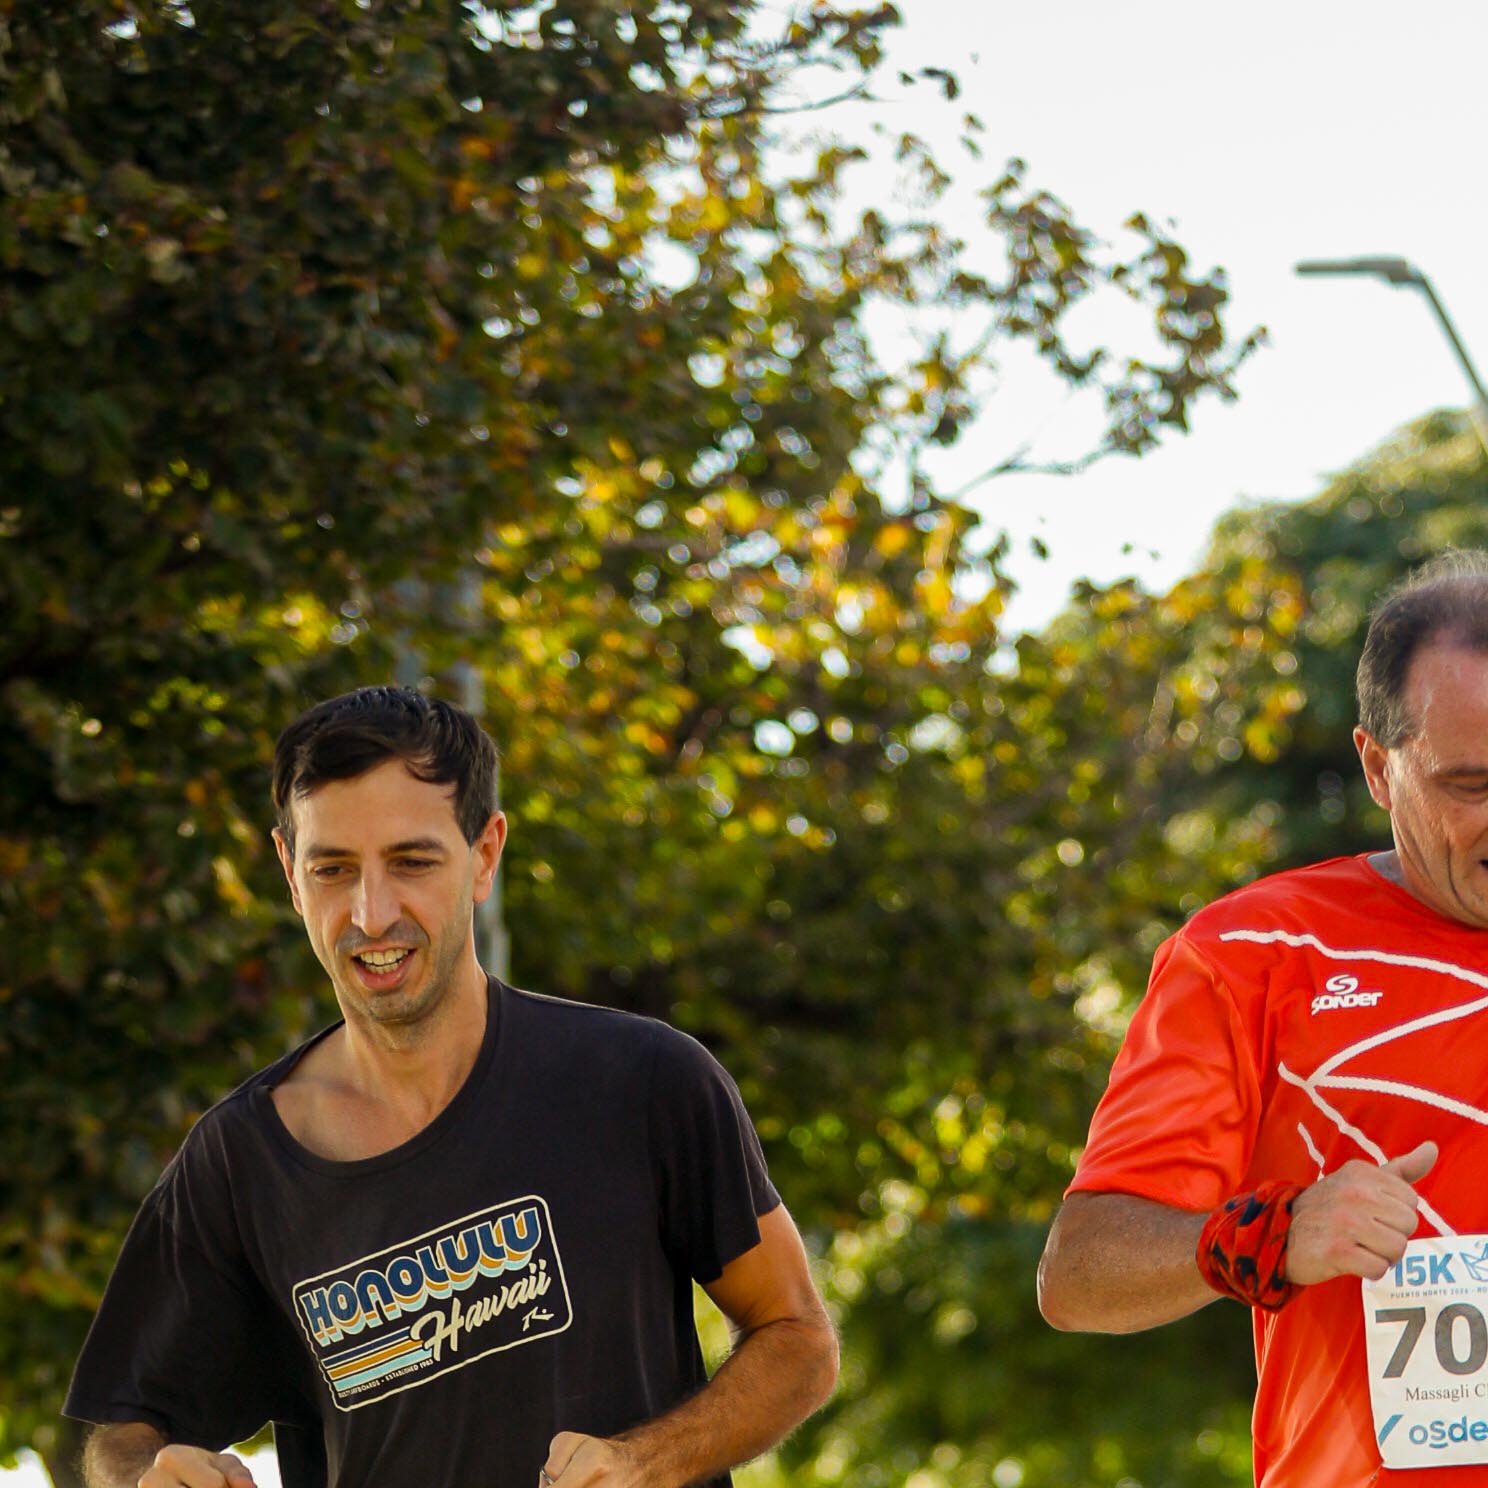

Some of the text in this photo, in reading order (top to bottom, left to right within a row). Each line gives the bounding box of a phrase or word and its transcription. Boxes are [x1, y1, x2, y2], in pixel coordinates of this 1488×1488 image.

[299, 1207, 541, 1347] HONOLULU
[1390, 1252, 1456, 1287] 15K
[410, 1259, 552, 1361] Hawaii
[1405, 1382, 1469, 1402] Massagli
[1409, 1415, 1488, 1448] osde
